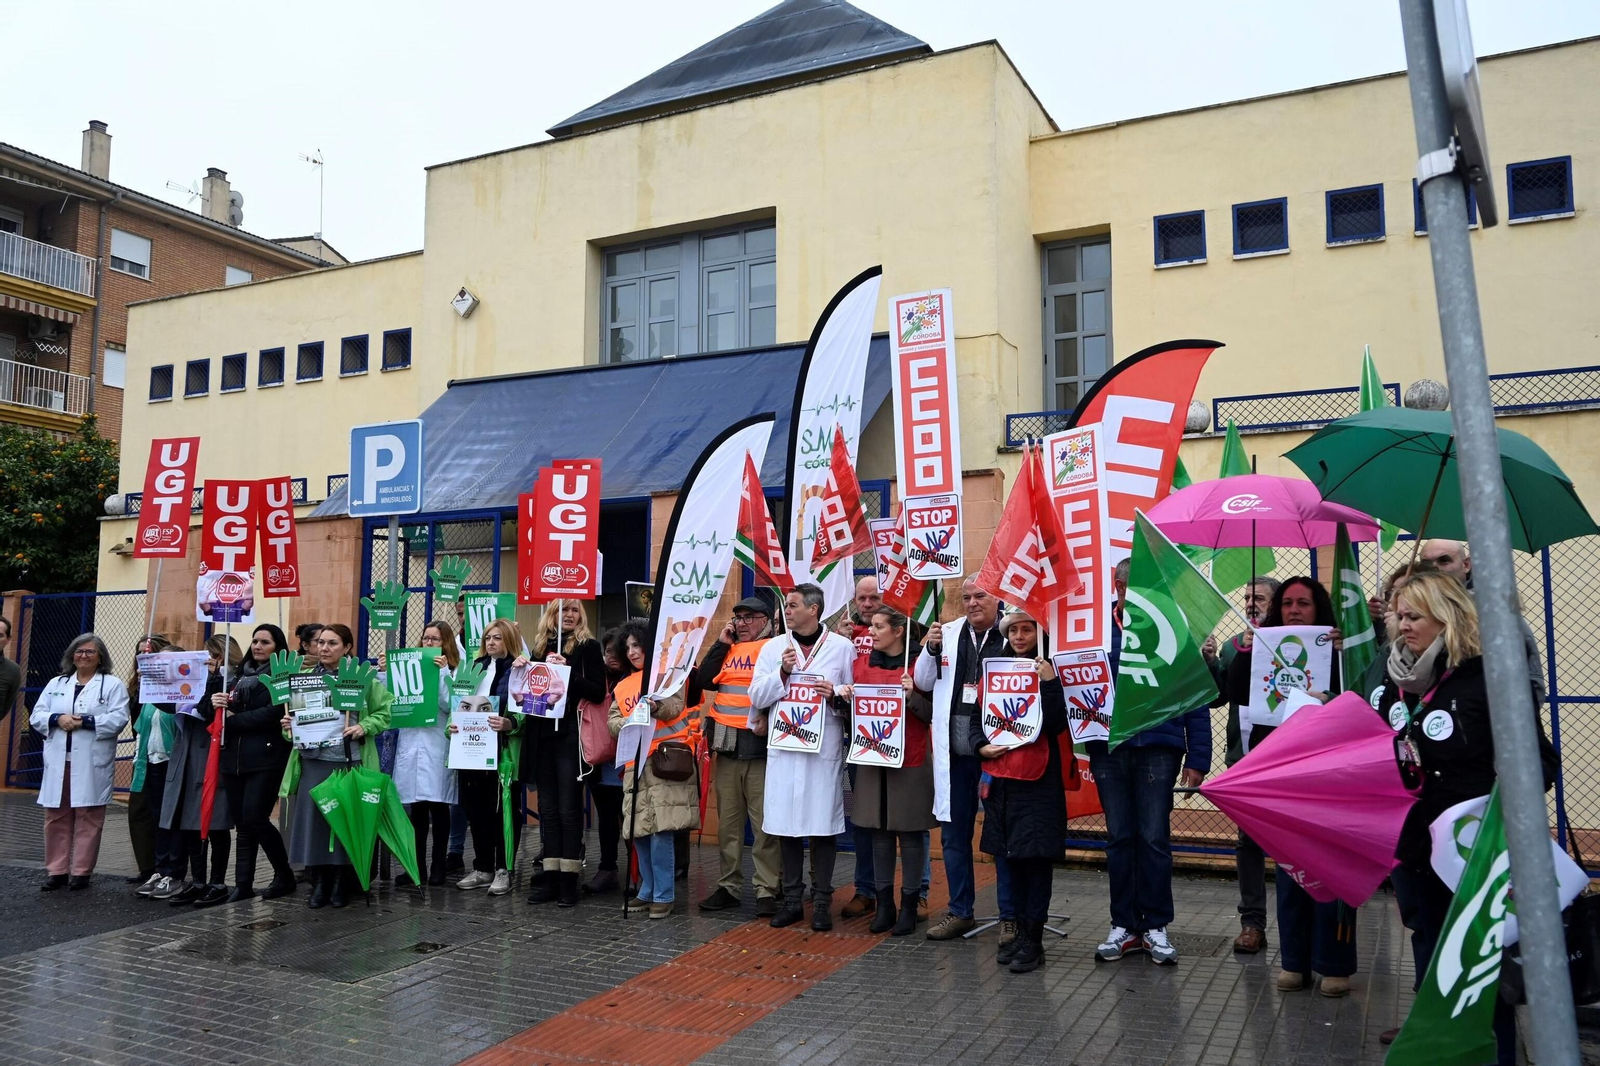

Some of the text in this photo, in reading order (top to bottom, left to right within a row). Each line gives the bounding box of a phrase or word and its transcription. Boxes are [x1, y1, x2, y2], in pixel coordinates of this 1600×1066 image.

[909, 356, 945, 488] CCOO
[363, 434, 406, 505] P
[152, 442, 191, 523] UGT
[379, 484, 410, 494] AMBULANCIAS
[266, 482, 292, 563] UGT
[548, 473, 589, 561] UGT
[910, 508, 953, 527] STOP
[213, 485, 250, 572] UGT
[925, 529, 950, 552] NO
[909, 548, 959, 567] AGRESIONES
[544, 566, 562, 577] UGT
[565, 567, 579, 575] FSP
[1063, 499, 1095, 643] CCOO
[219, 583, 243, 594] STOP
[467, 597, 475, 605] LA
[468, 603, 497, 640] NO
[389, 650, 423, 662] LA AGRESIÓN
[390, 659, 424, 697] NO
[531, 674, 548, 686] STOP
[991, 674, 1033, 691] STOP
[1063, 665, 1103, 684] STOP
[858, 699, 898, 715] STOP
[1002, 697, 1029, 722] NO
[1081, 687, 1106, 711] NO
[298, 711, 334, 721] RESPETO
[791, 706, 813, 727] NO
[984, 714, 1035, 737] AGRESIONES
[1068, 708, 1112, 727] AGRESIONE
[1430, 720, 1447, 731] CSIF
[468, 734, 481, 742] NO
[773, 719, 819, 743] AGRESIONES
[871, 720, 893, 742] NO
[853, 734, 900, 759] AGRESIONES
